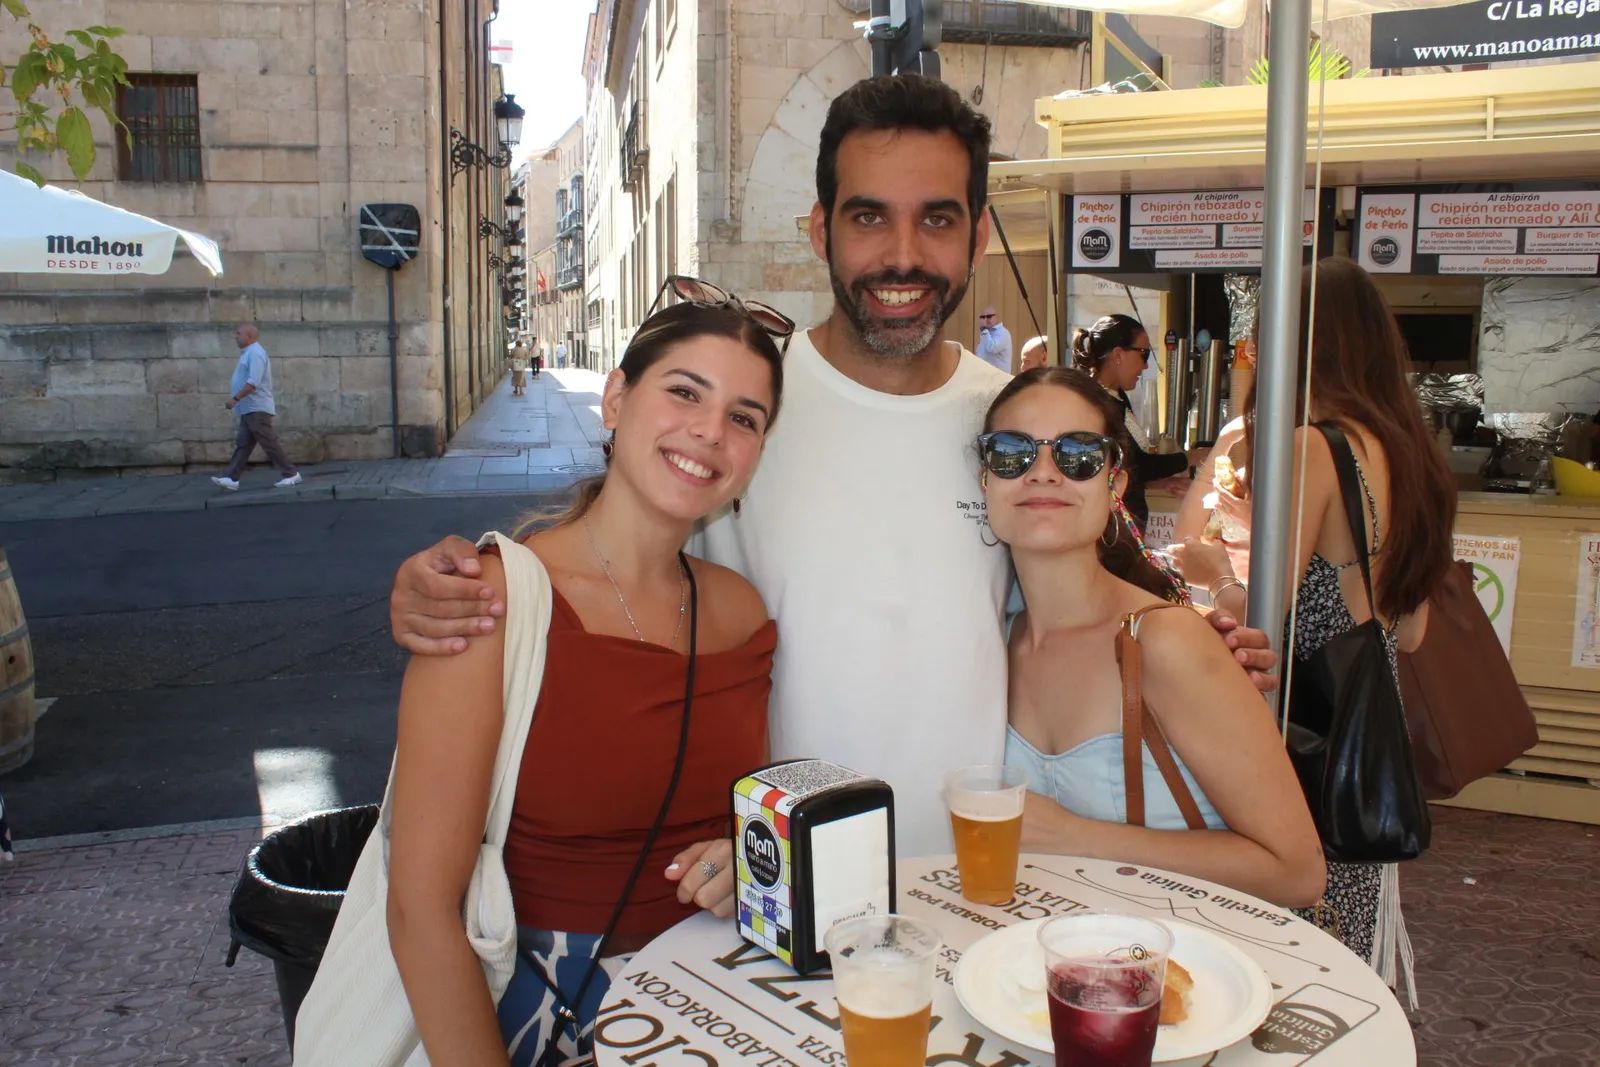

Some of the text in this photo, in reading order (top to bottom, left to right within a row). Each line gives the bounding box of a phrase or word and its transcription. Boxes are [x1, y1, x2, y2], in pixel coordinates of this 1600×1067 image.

[1487, 0, 1600, 21] C/ La Reja
[1193, 192, 1240, 202] Al chipirón
[1487, 193, 1540, 203] Al chipirón
[1079, 201, 1115, 213] Pinchos
[1140, 200, 1191, 214] Chipirón
[1194, 199, 1252, 211] rebozado
[1367, 205, 1408, 218] Pinchos
[1430, 201, 1489, 215] Chipirón
[1492, 200, 1560, 214] rebozado
[1565, 202, 1593, 212] con
[1077, 215, 1090, 224] de
[1150, 210, 1260, 223] recién horneado y
[1438, 212, 1481, 225] recién
[1485, 213, 1553, 225] horneado
[1558, 216, 1566, 226] y
[1570, 212, 1589, 224] Ali
[1365, 220, 1378, 230] de
[1536, 231, 1570, 240] Burguer
[1572, 231, 1584, 239] de
[46, 235, 144, 257] Mahou
[1219, 251, 1229, 259] de
[1230, 251, 1249, 260] pollo
[1483, 256, 1548, 266] Asado de pollo
[47, 260, 99, 270] DESDE
[956, 500, 970, 511] Day
[971, 501, 981, 510] To
[1482, 550, 1489, 558] Y
[1493, 551, 1515, 560] PAN
[906, 888, 943, 905] POR
[1036, 891, 1089, 912] LIA
[1140, 871, 1295, 927] Estrella Galicia
[1271, 1009, 1335, 1040] Galicia
[1262, 1021, 1326, 1051] Estrell
[796, 1035, 847, 1067] STA
